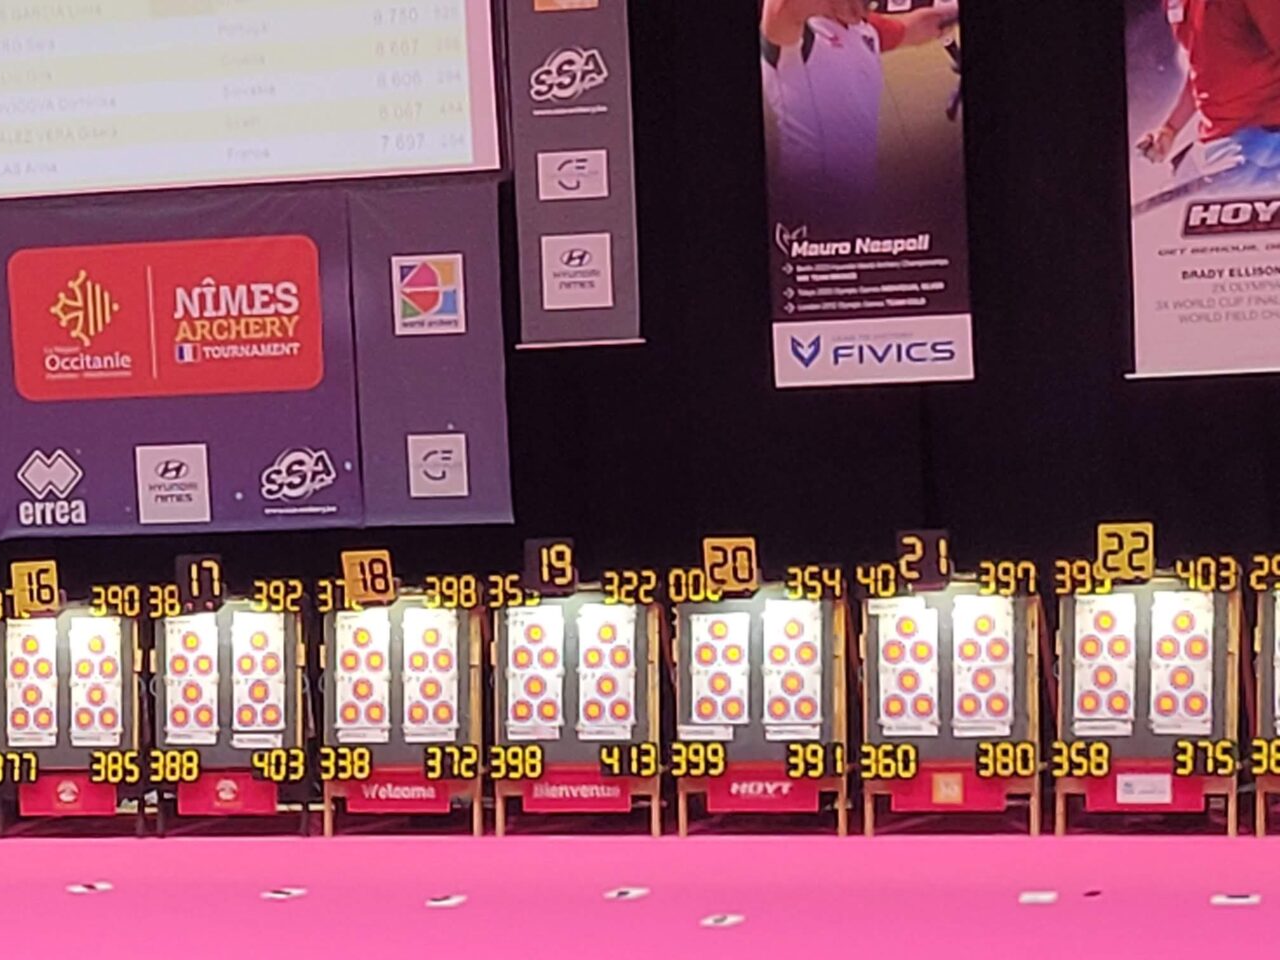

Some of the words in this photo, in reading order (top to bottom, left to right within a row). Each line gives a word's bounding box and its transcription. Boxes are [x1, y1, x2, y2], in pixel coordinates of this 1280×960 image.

[531, 49, 608, 100] SSA
[790, 240, 852, 258] Mauro
[854, 233, 930, 256] Nespoli
[1182, 269, 1224, 280] BRADY
[173, 276, 301, 320] NÎMES
[174, 315, 300, 342] ARCHERY
[44, 352, 133, 372] Occitanie
[203, 341, 301, 359] TOURNAMENT
[832, 340, 956, 366] FIVICS
[261, 448, 336, 500] SSA
[541, 544, 573, 586] 19
[709, 545, 753, 584] 20
[899, 536, 948, 579] 21
[1102, 531, 1149, 572] 22
[26, 568, 52, 604] 16
[191, 560, 220, 597] 17
[359, 558, 390, 593] 18
[604, 570, 657, 604] 322
[786, 564, 842, 600] 354
[979, 560, 1036, 596] 397
[1176, 555, 1237, 592] 403
[91, 584, 140, 617] 390
[254, 579, 303, 612] 392
[425, 574, 476, 609] 398
[91, 751, 140, 783] 385
[150, 749, 199, 782] 388
[252, 749, 304, 781] 403
[320, 747, 370, 779] 338
[427, 745, 478, 779] 372
[490, 745, 543, 779] 398
[601, 743, 657, 776] 413
[671, 742, 725, 777] 399
[789, 743, 843, 778] 391
[861, 743, 917, 778] 360
[978, 742, 1035, 777] 380
[1052, 740, 1109, 777] 358
[1176, 740, 1234, 776] 375
[361, 783, 436, 800] Welcome
[730, 781, 793, 797] HOYT
